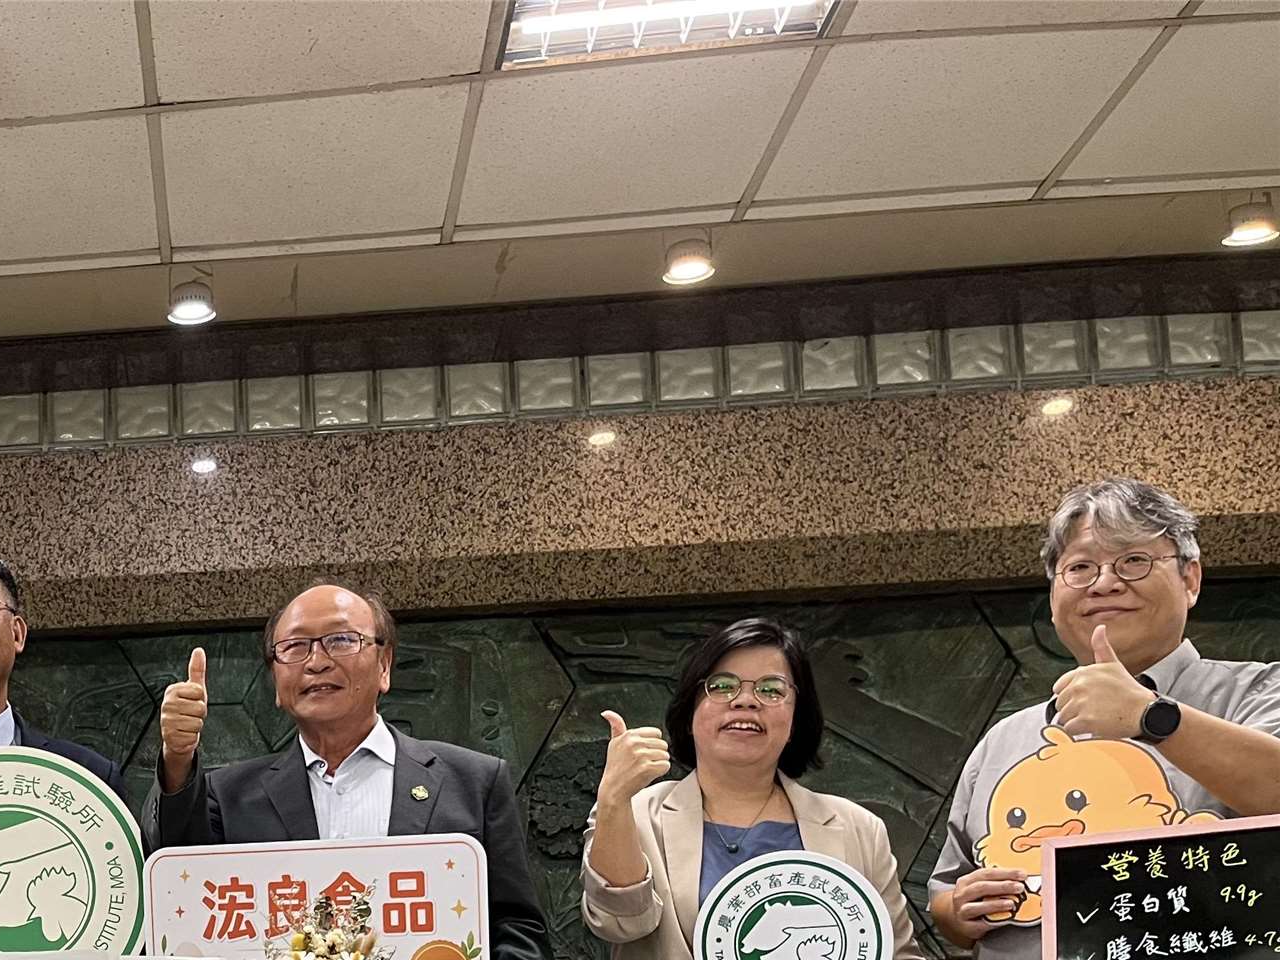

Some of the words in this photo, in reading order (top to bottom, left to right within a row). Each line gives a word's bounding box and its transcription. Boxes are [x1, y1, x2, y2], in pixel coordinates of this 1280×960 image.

[107, 856, 125, 888] MOA
[1101, 842, 1247, 881] 營養特色
[717, 871, 865, 932] 農業部畜產試驗所
[1109, 885, 1190, 922] 蛋白質
[1220, 883, 1263, 906] 9.9g
